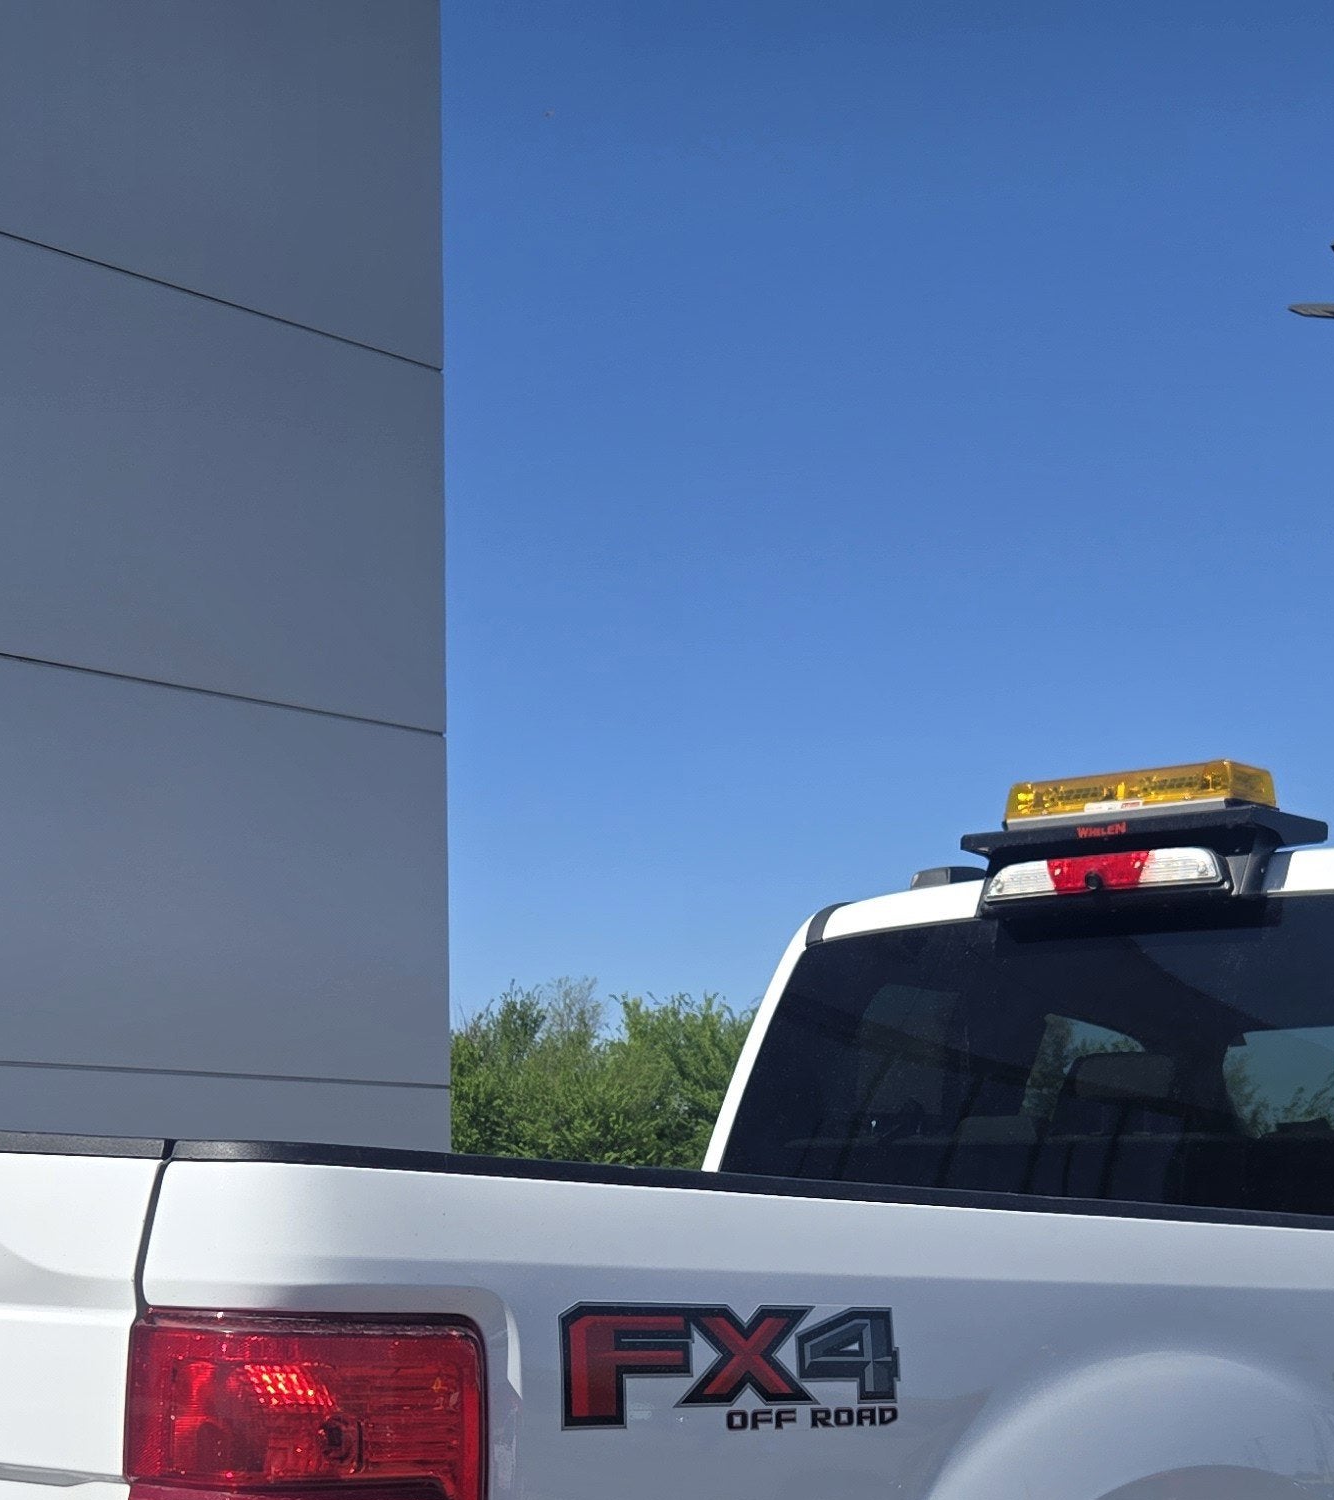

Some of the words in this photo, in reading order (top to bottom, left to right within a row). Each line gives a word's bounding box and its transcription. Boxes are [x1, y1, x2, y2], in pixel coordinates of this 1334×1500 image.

[558, 1301, 900, 1431] FX4
[725, 1407, 797, 1431] OFF
[810, 1405, 899, 1429] ROAD
